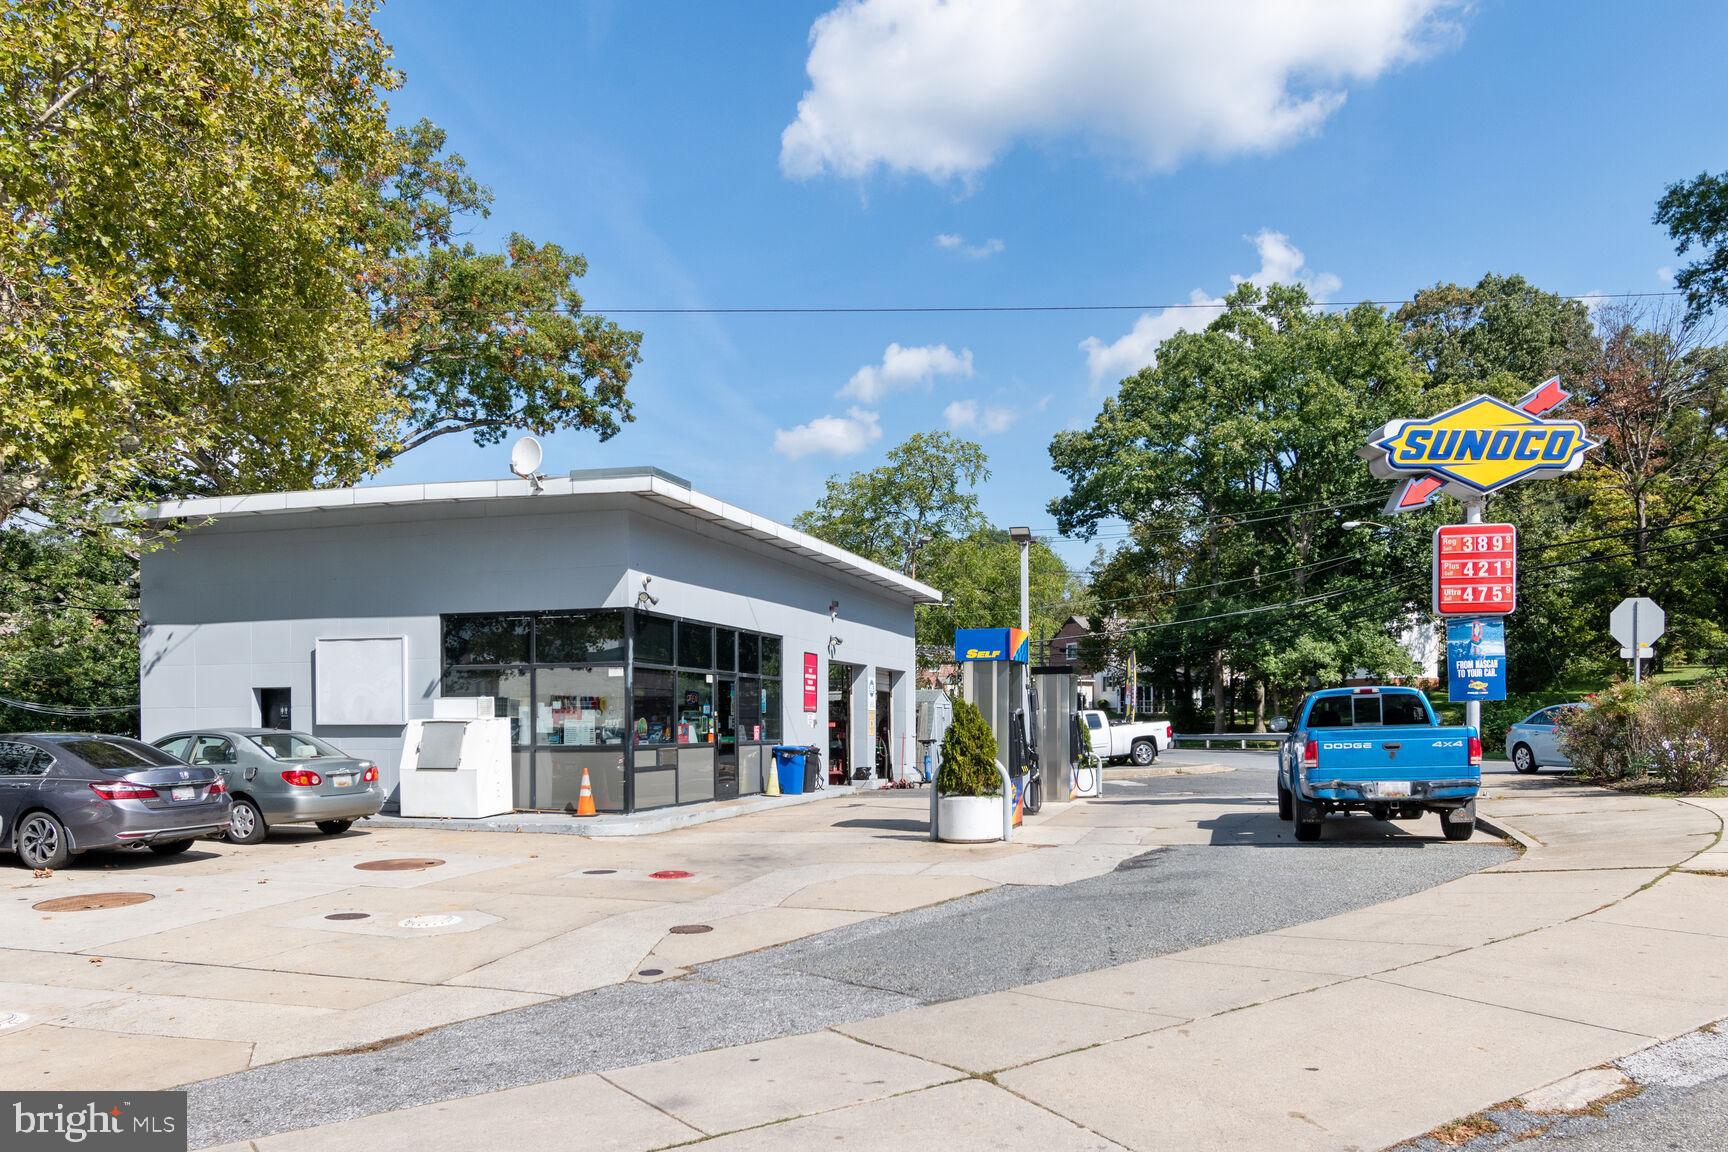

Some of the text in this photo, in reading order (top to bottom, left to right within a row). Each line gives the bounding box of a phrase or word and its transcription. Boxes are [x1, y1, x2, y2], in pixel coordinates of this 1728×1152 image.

[1400, 429, 1575, 460] SUNOCO
[1443, 538, 1456, 546] Reg
[1456, 660, 1498, 669] FROM NASCAR
[1457, 669, 1465, 678] TO
[1467, 669, 1483, 677] YOUR
[1323, 742, 1372, 750] DODGE
